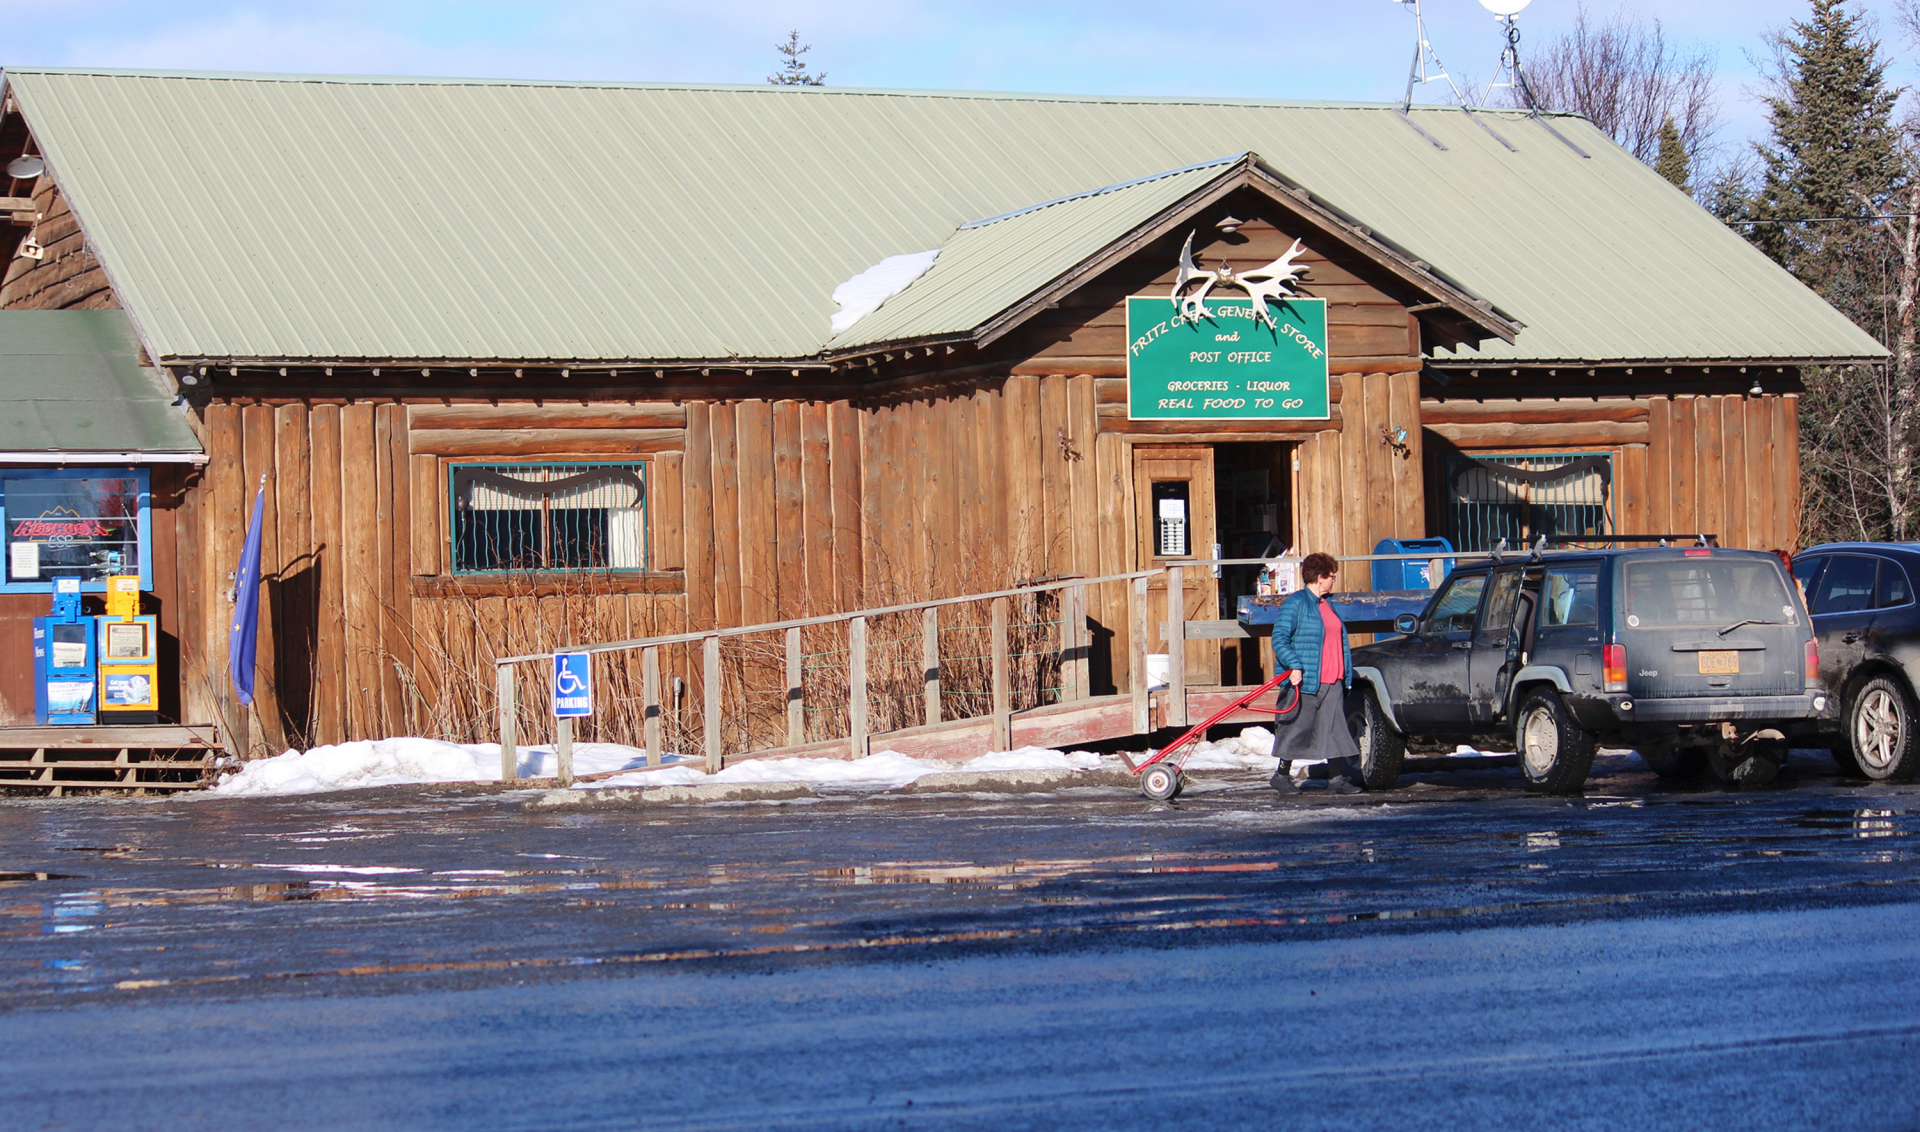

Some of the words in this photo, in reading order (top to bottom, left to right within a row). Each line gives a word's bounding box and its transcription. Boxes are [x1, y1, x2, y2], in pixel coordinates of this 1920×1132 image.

[1130, 321, 1169, 356] FRITZ
[1280, 323, 1324, 360] STORE
[1214, 331, 1241, 342] and
[1189, 351, 1222, 363] POST
[1227, 351, 1272, 364] OFFICE
[1167, 380, 1229, 392] GROCERIES
[1246, 380, 1291, 393] LIQUOR
[1158, 398, 1194, 410] REAL
[1202, 398, 1246, 410] FOOD
[1254, 398, 1275, 409] TO
[1281, 398, 1304, 409] GO
[13, 519, 110, 536] REDHOOK
[1722, 655, 1738, 668] 769
[1638, 669, 1658, 678] Jeep
[556, 696, 588, 709] PARKING
